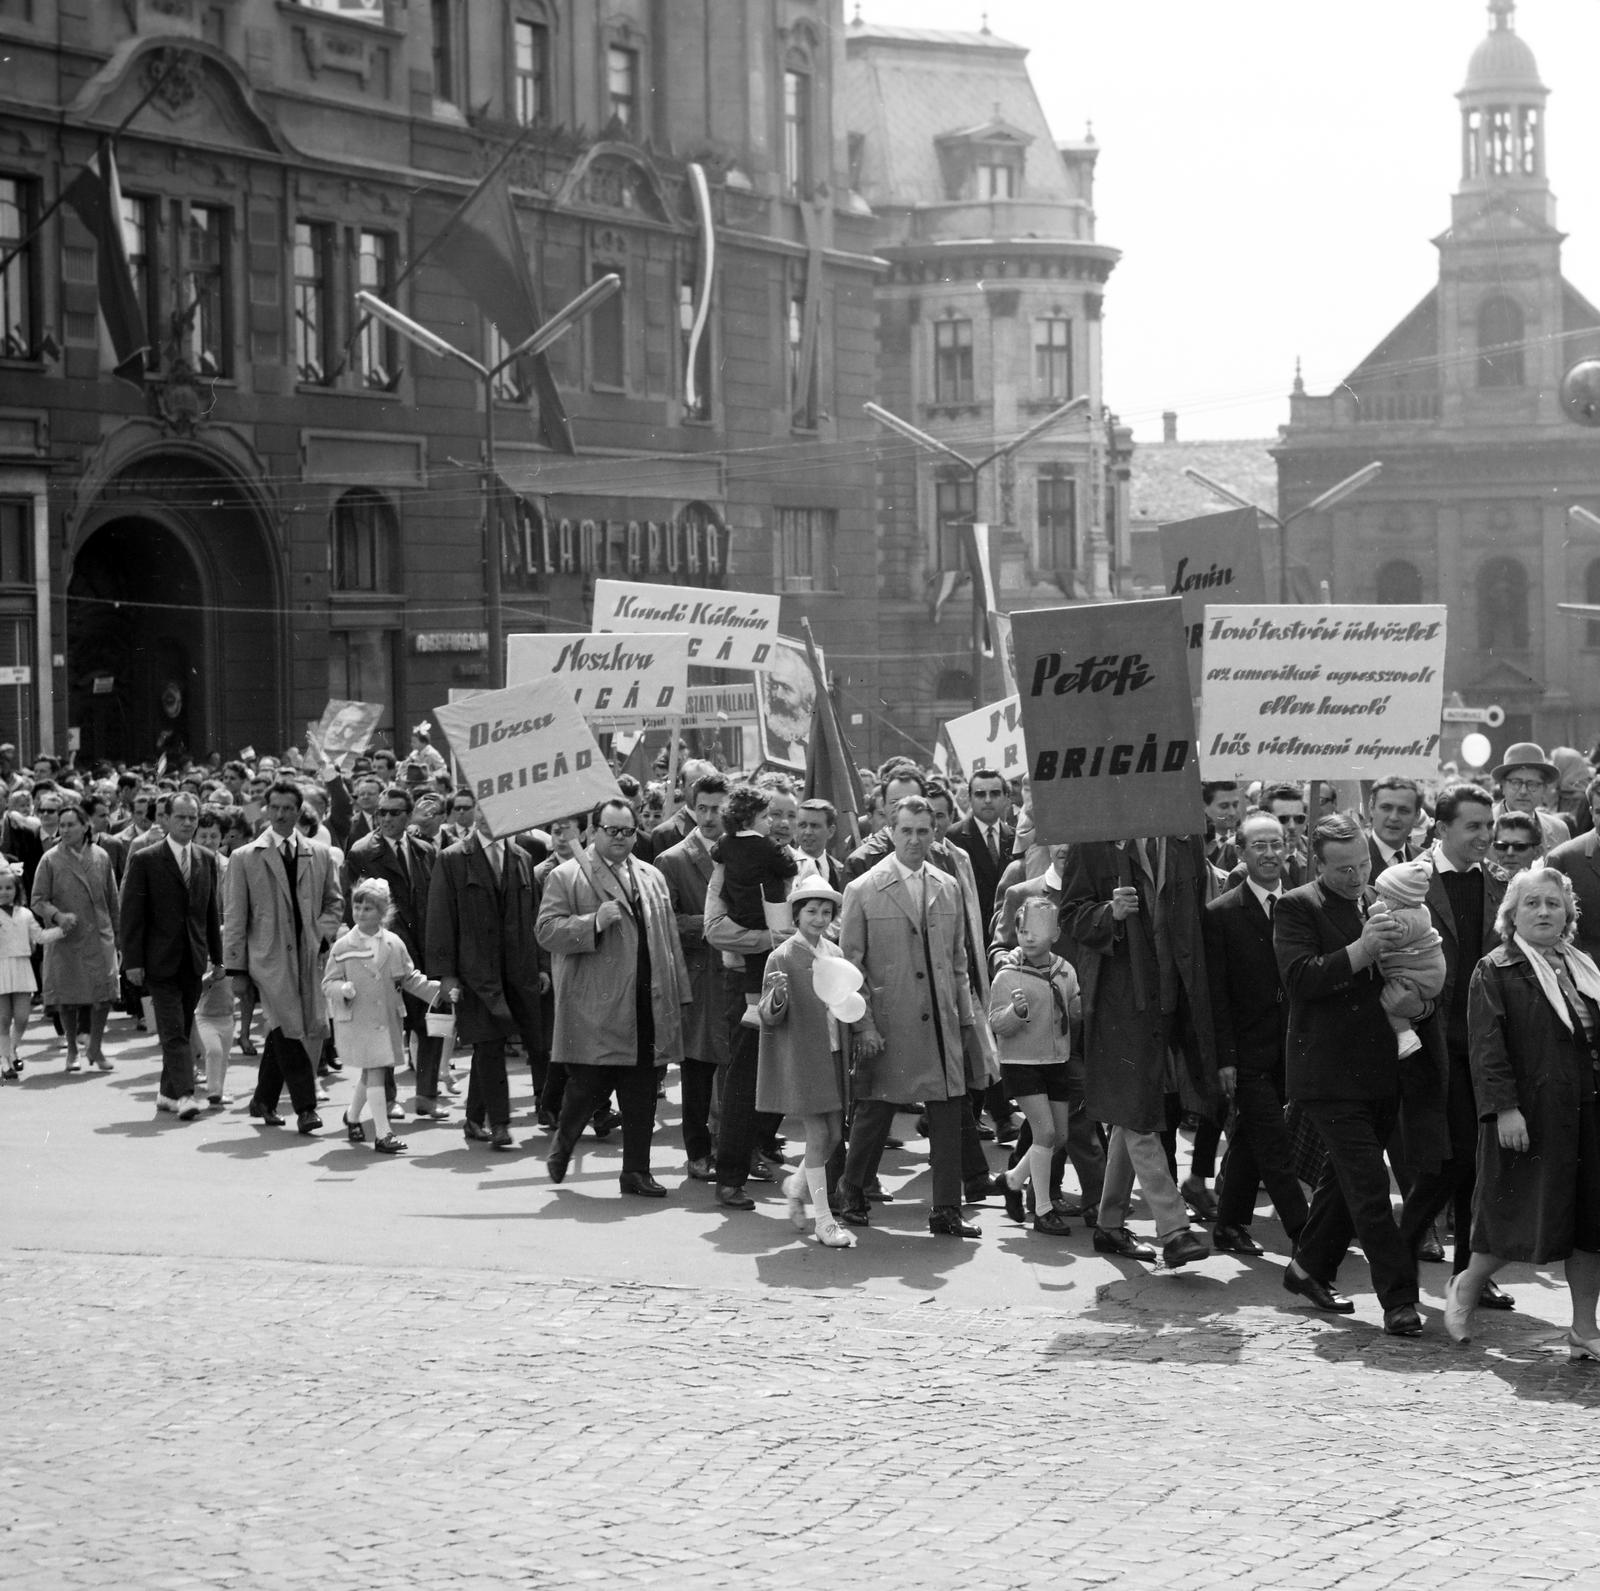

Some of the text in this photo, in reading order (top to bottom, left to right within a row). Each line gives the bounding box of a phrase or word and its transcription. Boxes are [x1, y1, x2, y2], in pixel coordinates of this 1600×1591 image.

[1171, 557, 1235, 595] Lenin
[613, 595, 770, 631] Kandó Kálmán
[1343, 621, 1442, 642] üdvözlet
[552, 637, 655, 674] Moszkva
[687, 636, 771, 664] GÁD
[1031, 653, 1156, 697] Petőfi
[1206, 664, 1437, 685] az amerikai agresszorok
[574, 680, 675, 710] IGÁD
[685, 694, 714, 714] SZATI
[1259, 695, 1392, 715] ellen harcoló
[469, 713, 556, 750] Dózsa
[1209, 733, 1440, 760] hős vietnami népnek!
[1034, 733, 1189, 781] BRIGÁD
[477, 749, 592, 800] BRIGÁD
